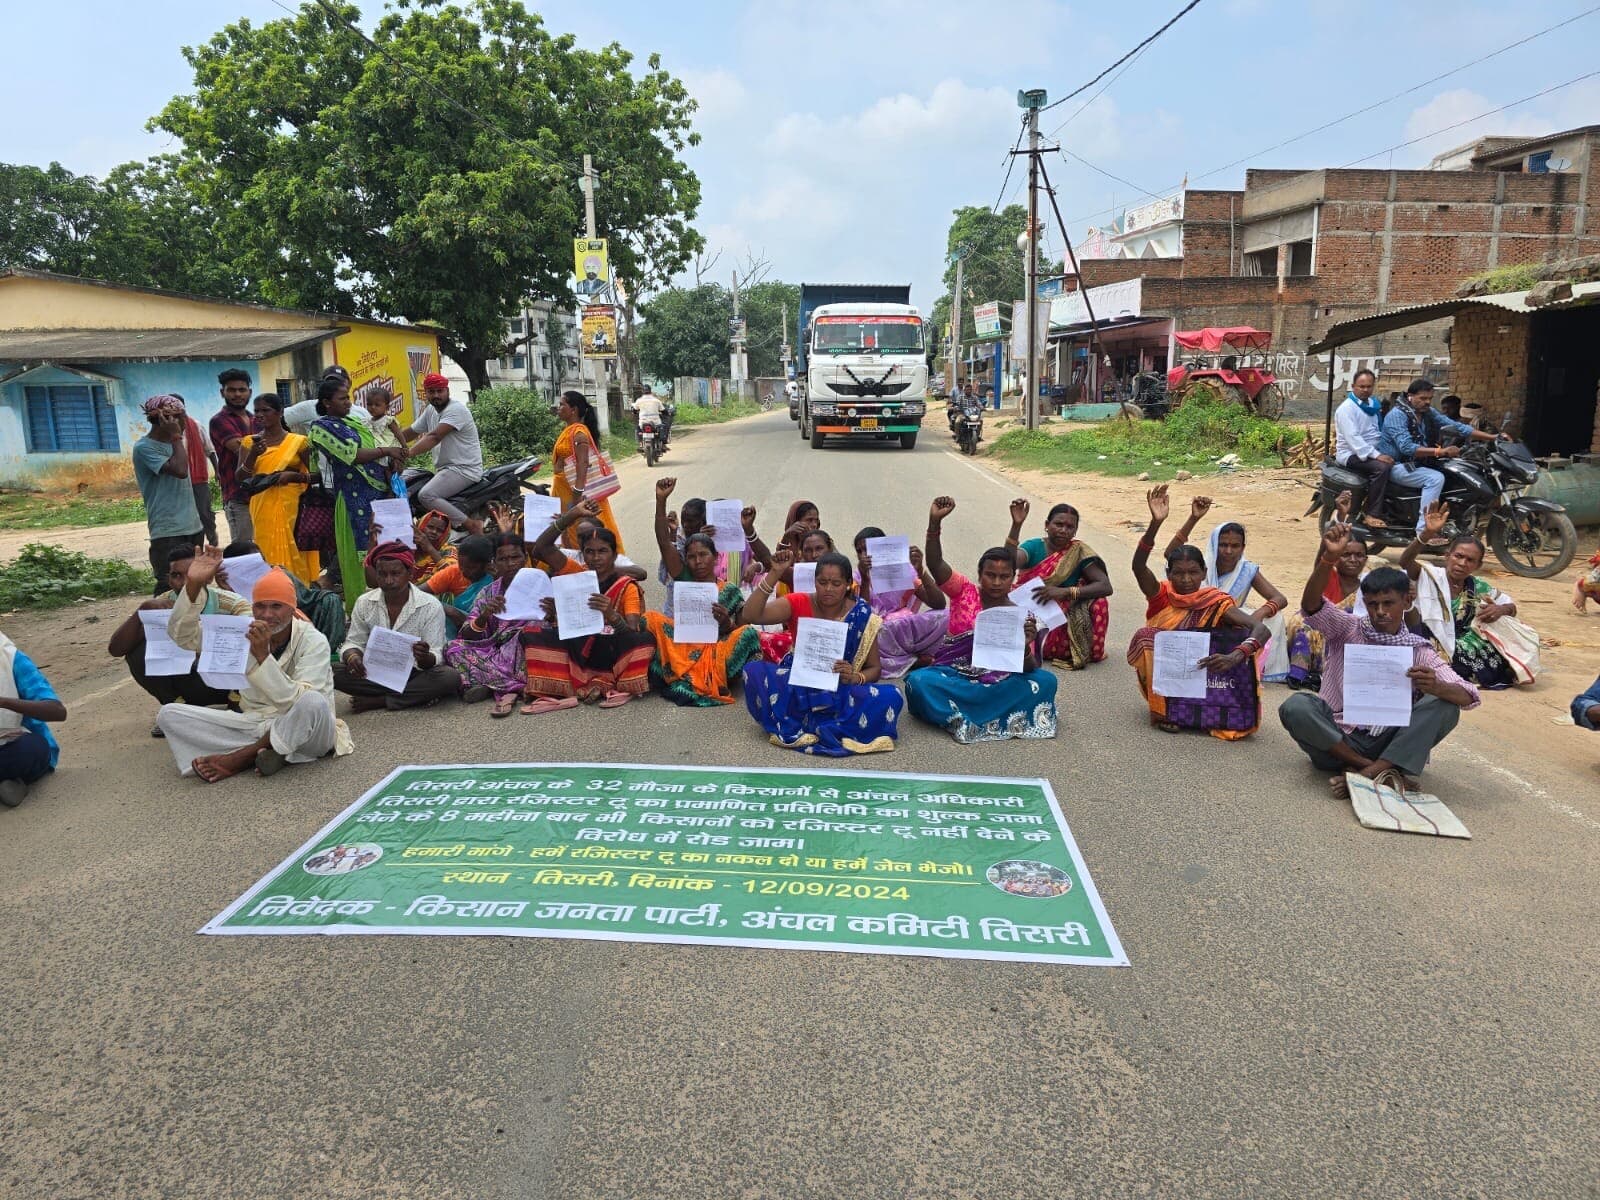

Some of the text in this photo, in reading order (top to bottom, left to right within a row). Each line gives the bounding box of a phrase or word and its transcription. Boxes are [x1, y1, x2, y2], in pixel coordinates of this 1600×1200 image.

[405, 779, 1024, 807] तिसरी अंचल के 32 मौजा के किसानों से अंचल अधिकारी
[377, 793, 1043, 824] तिसरी द्वारा रजिस्टर टू का प्रमाणित प्रतिलिपि का शुल्क जमा
[353, 809, 1051, 842] लेने के 8 महीना बाद भी किसानों को रजिस्टर टू नहीं देने के
[575, 828, 649, 842] विरोध
[654, 831, 682, 844] में
[686, 832, 732, 845] रोड
[402, 844, 466, 857] हमारी
[529, 845, 569, 858] हमें
[571, 846, 654, 860] रजिस्टर
[658, 851, 676, 865] टू
[681, 852, 710, 863] का
[715, 854, 773, 866] नकल
[779, 854, 799, 867] दो
[805, 858, 827, 868] या
[832, 857, 868, 870] हमें
[873, 858, 912, 872] जेल
[442, 872, 512, 884] स्थान
[628, 873, 716, 891] दिनांक
[743, 880, 910, 900] 12/09/2024
[248, 895, 380, 916] निवेदक
[403, 895, 530, 917] किसान
[534, 902, 637, 922] जनता
[741, 906, 837, 932] अंचल
[846, 913, 969, 939] कमिटी
[978, 917, 1091, 946] तिसरी
